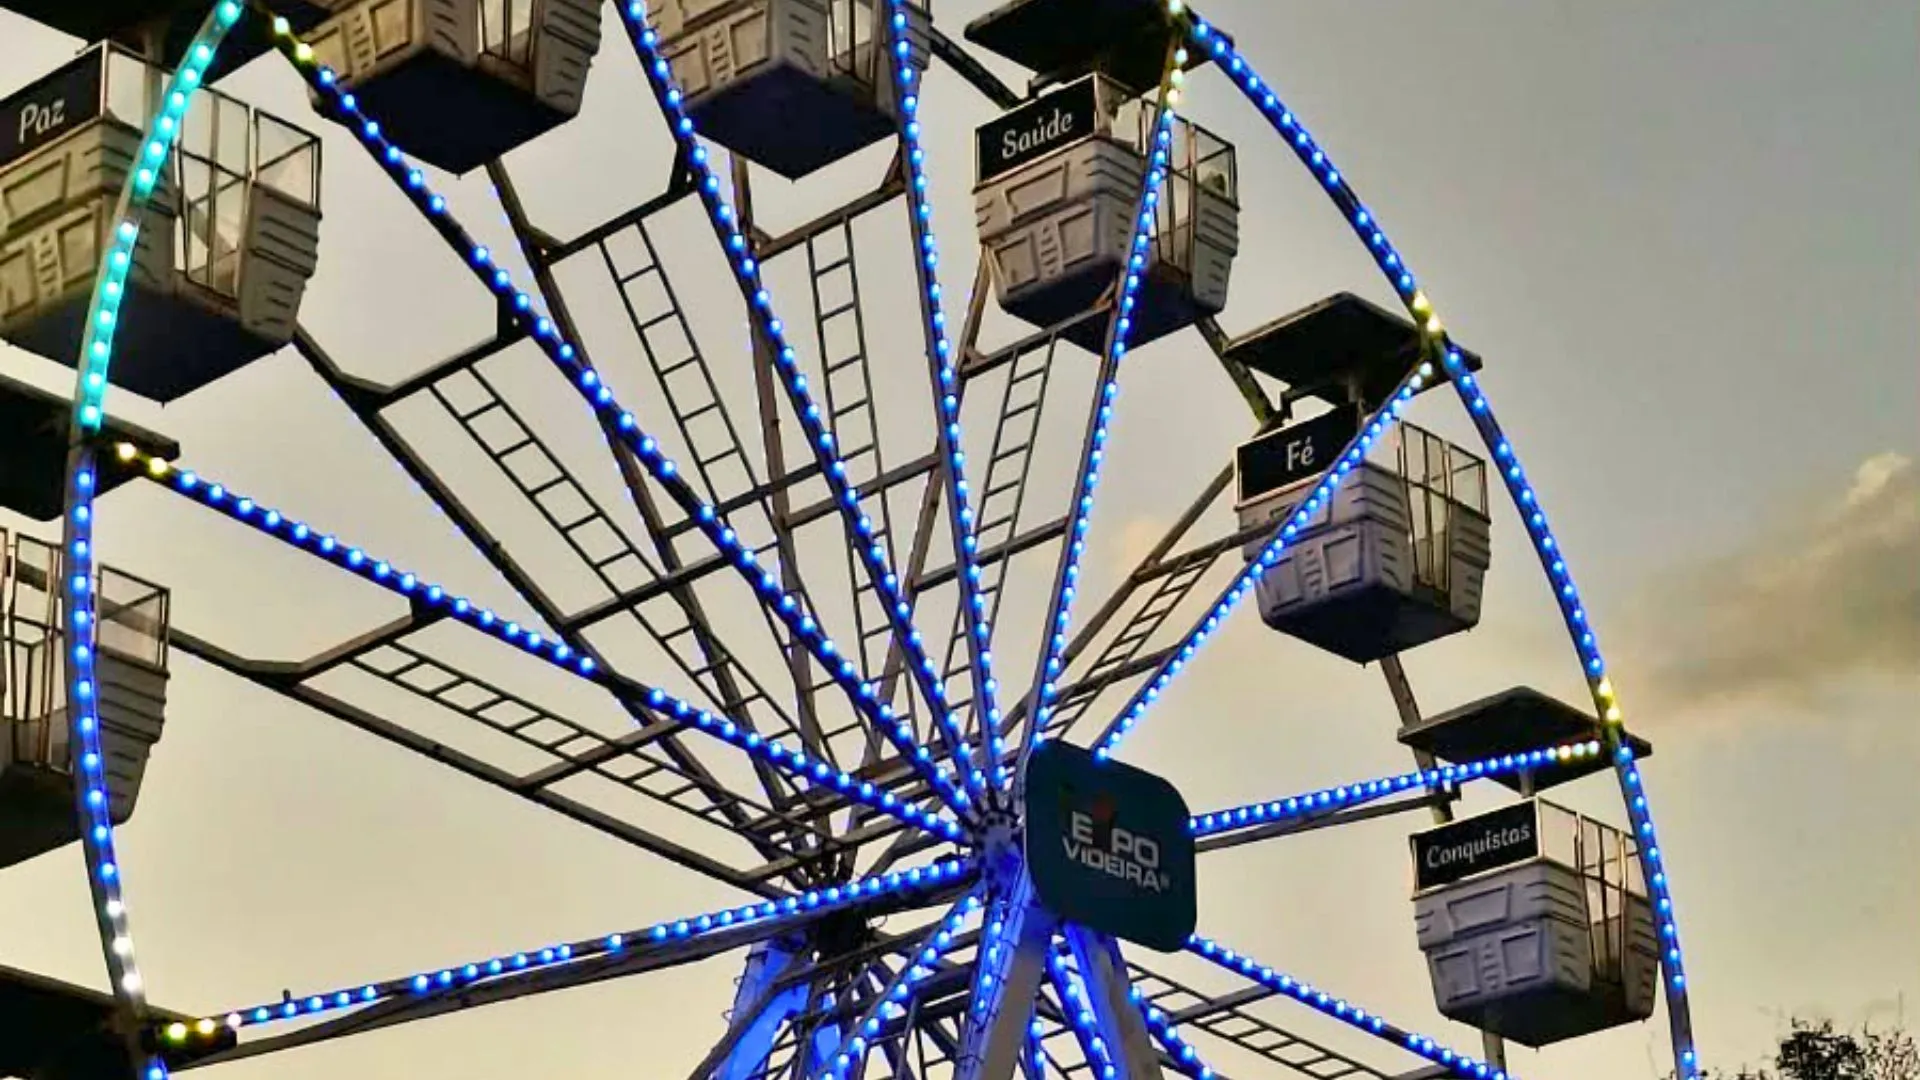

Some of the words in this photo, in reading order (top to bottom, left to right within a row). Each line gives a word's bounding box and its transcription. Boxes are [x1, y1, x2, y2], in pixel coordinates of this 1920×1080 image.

[19, 98, 65, 144] Paz
[1002, 108, 1074, 159] Saúde
[1287, 435, 1315, 471] Fé
[1426, 823, 1531, 868] Conquistas
